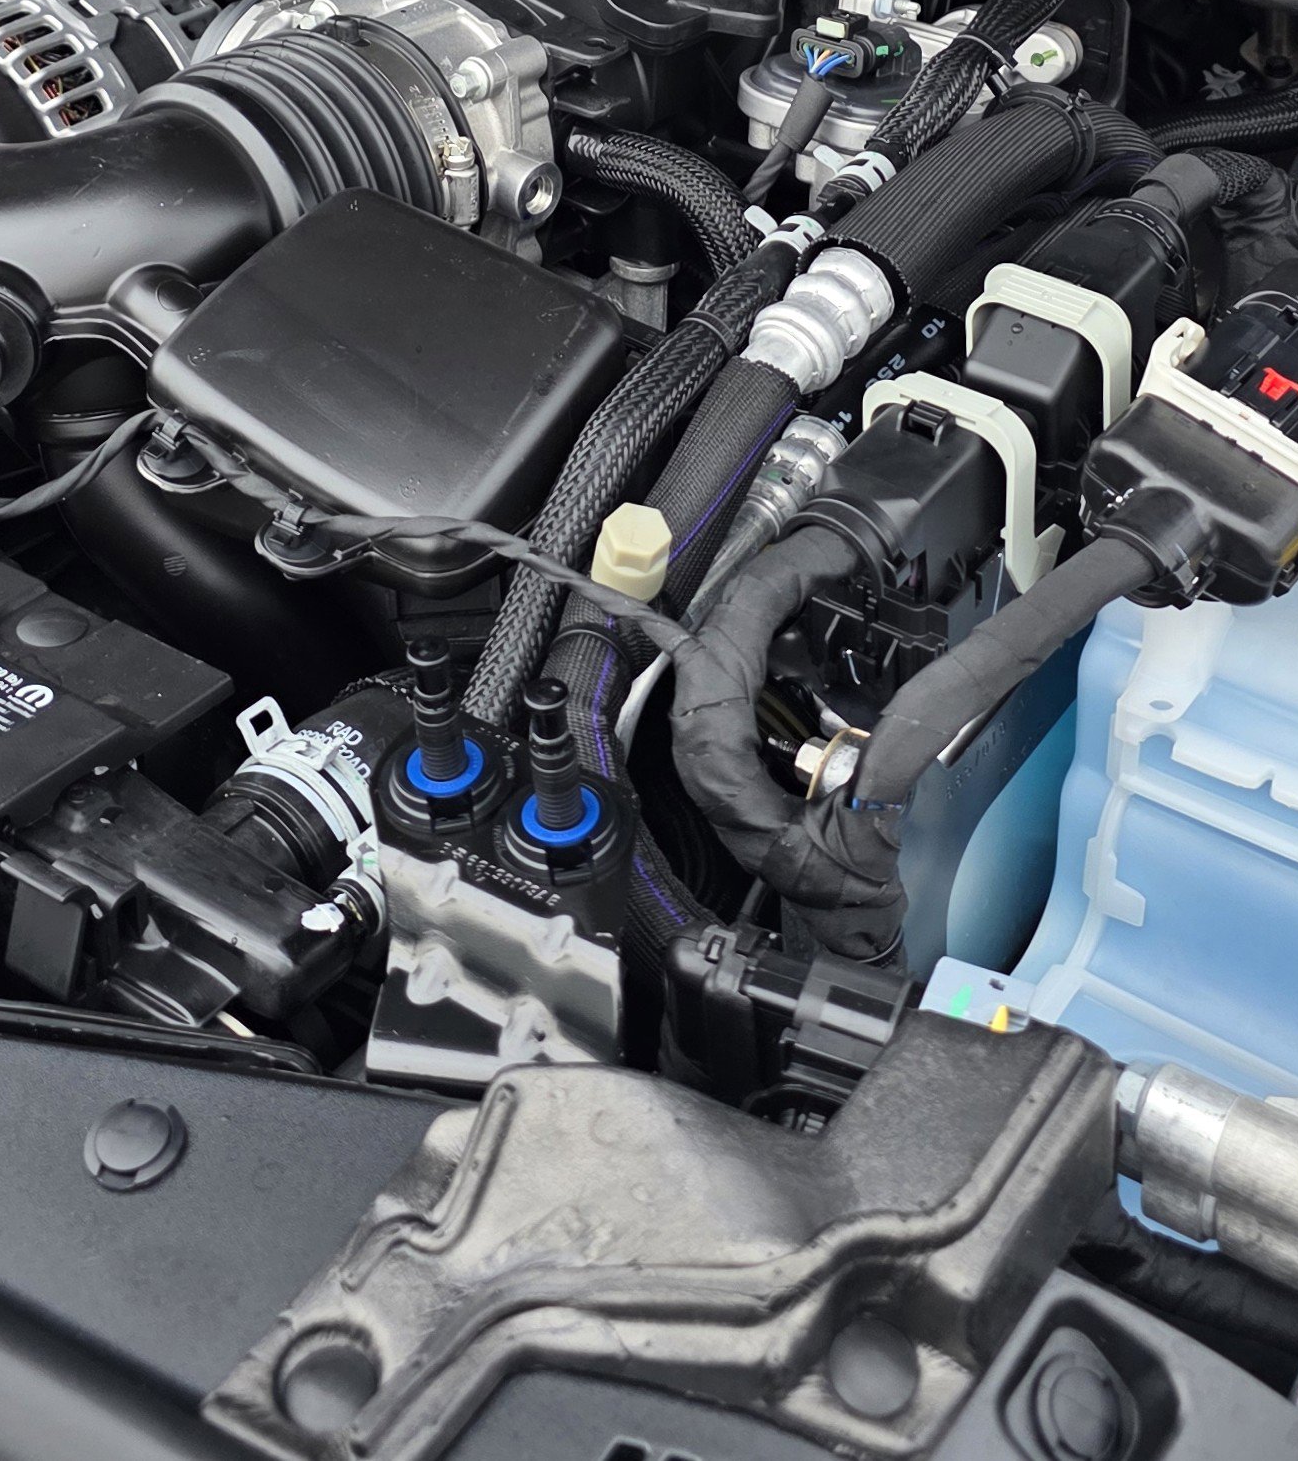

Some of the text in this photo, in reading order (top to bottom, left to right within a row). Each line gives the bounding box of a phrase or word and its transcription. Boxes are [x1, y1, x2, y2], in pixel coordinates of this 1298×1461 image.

[921, 318, 946, 339] 10
[865, 353, 906, 389] 25
[325, 720, 363, 746] RAD
